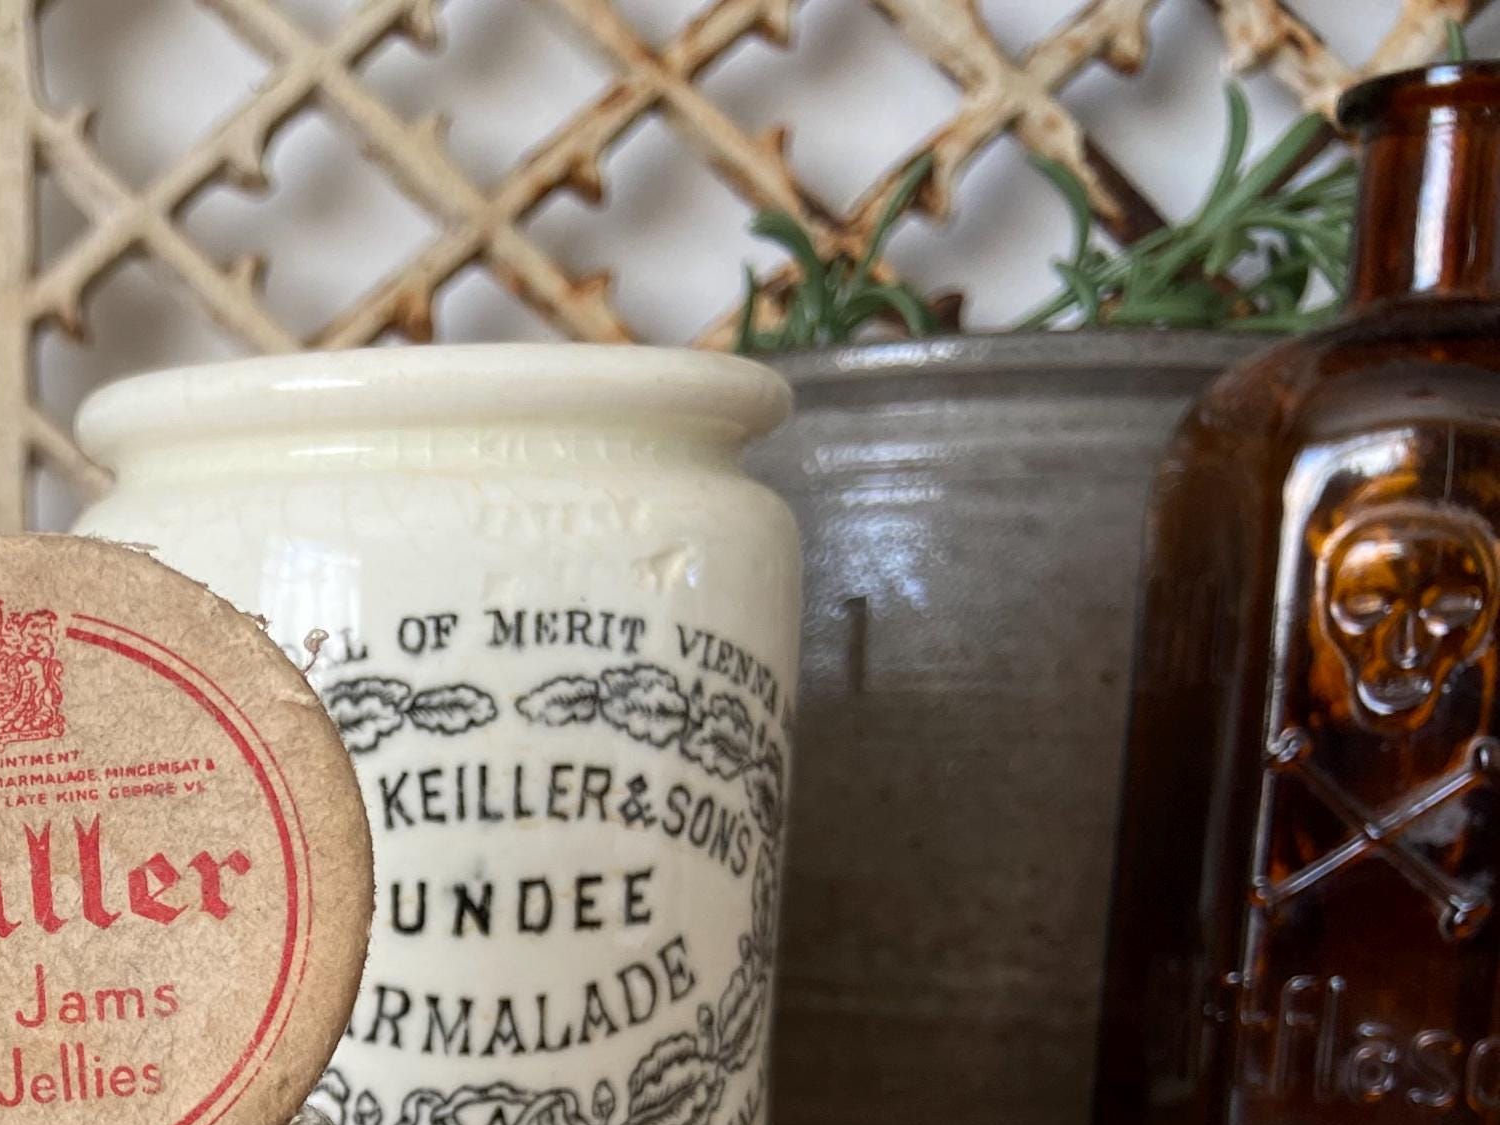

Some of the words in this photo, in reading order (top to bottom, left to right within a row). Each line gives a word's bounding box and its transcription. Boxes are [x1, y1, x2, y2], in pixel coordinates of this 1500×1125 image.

[397, 613, 458, 654] OF
[485, 609, 647, 654] MERIT
[676, 623, 779, 717] VIENNA
[5, 793, 48, 807] LATE
[56, 789, 100, 804] KING
[108, 781, 178, 799] GEORGE
[104, 759, 200, 779] MINCEMEAT
[390, 865, 654, 937] UNDEE
[15, 964, 180, 1030] Jams
[346, 935, 697, 1057] RMALADE
